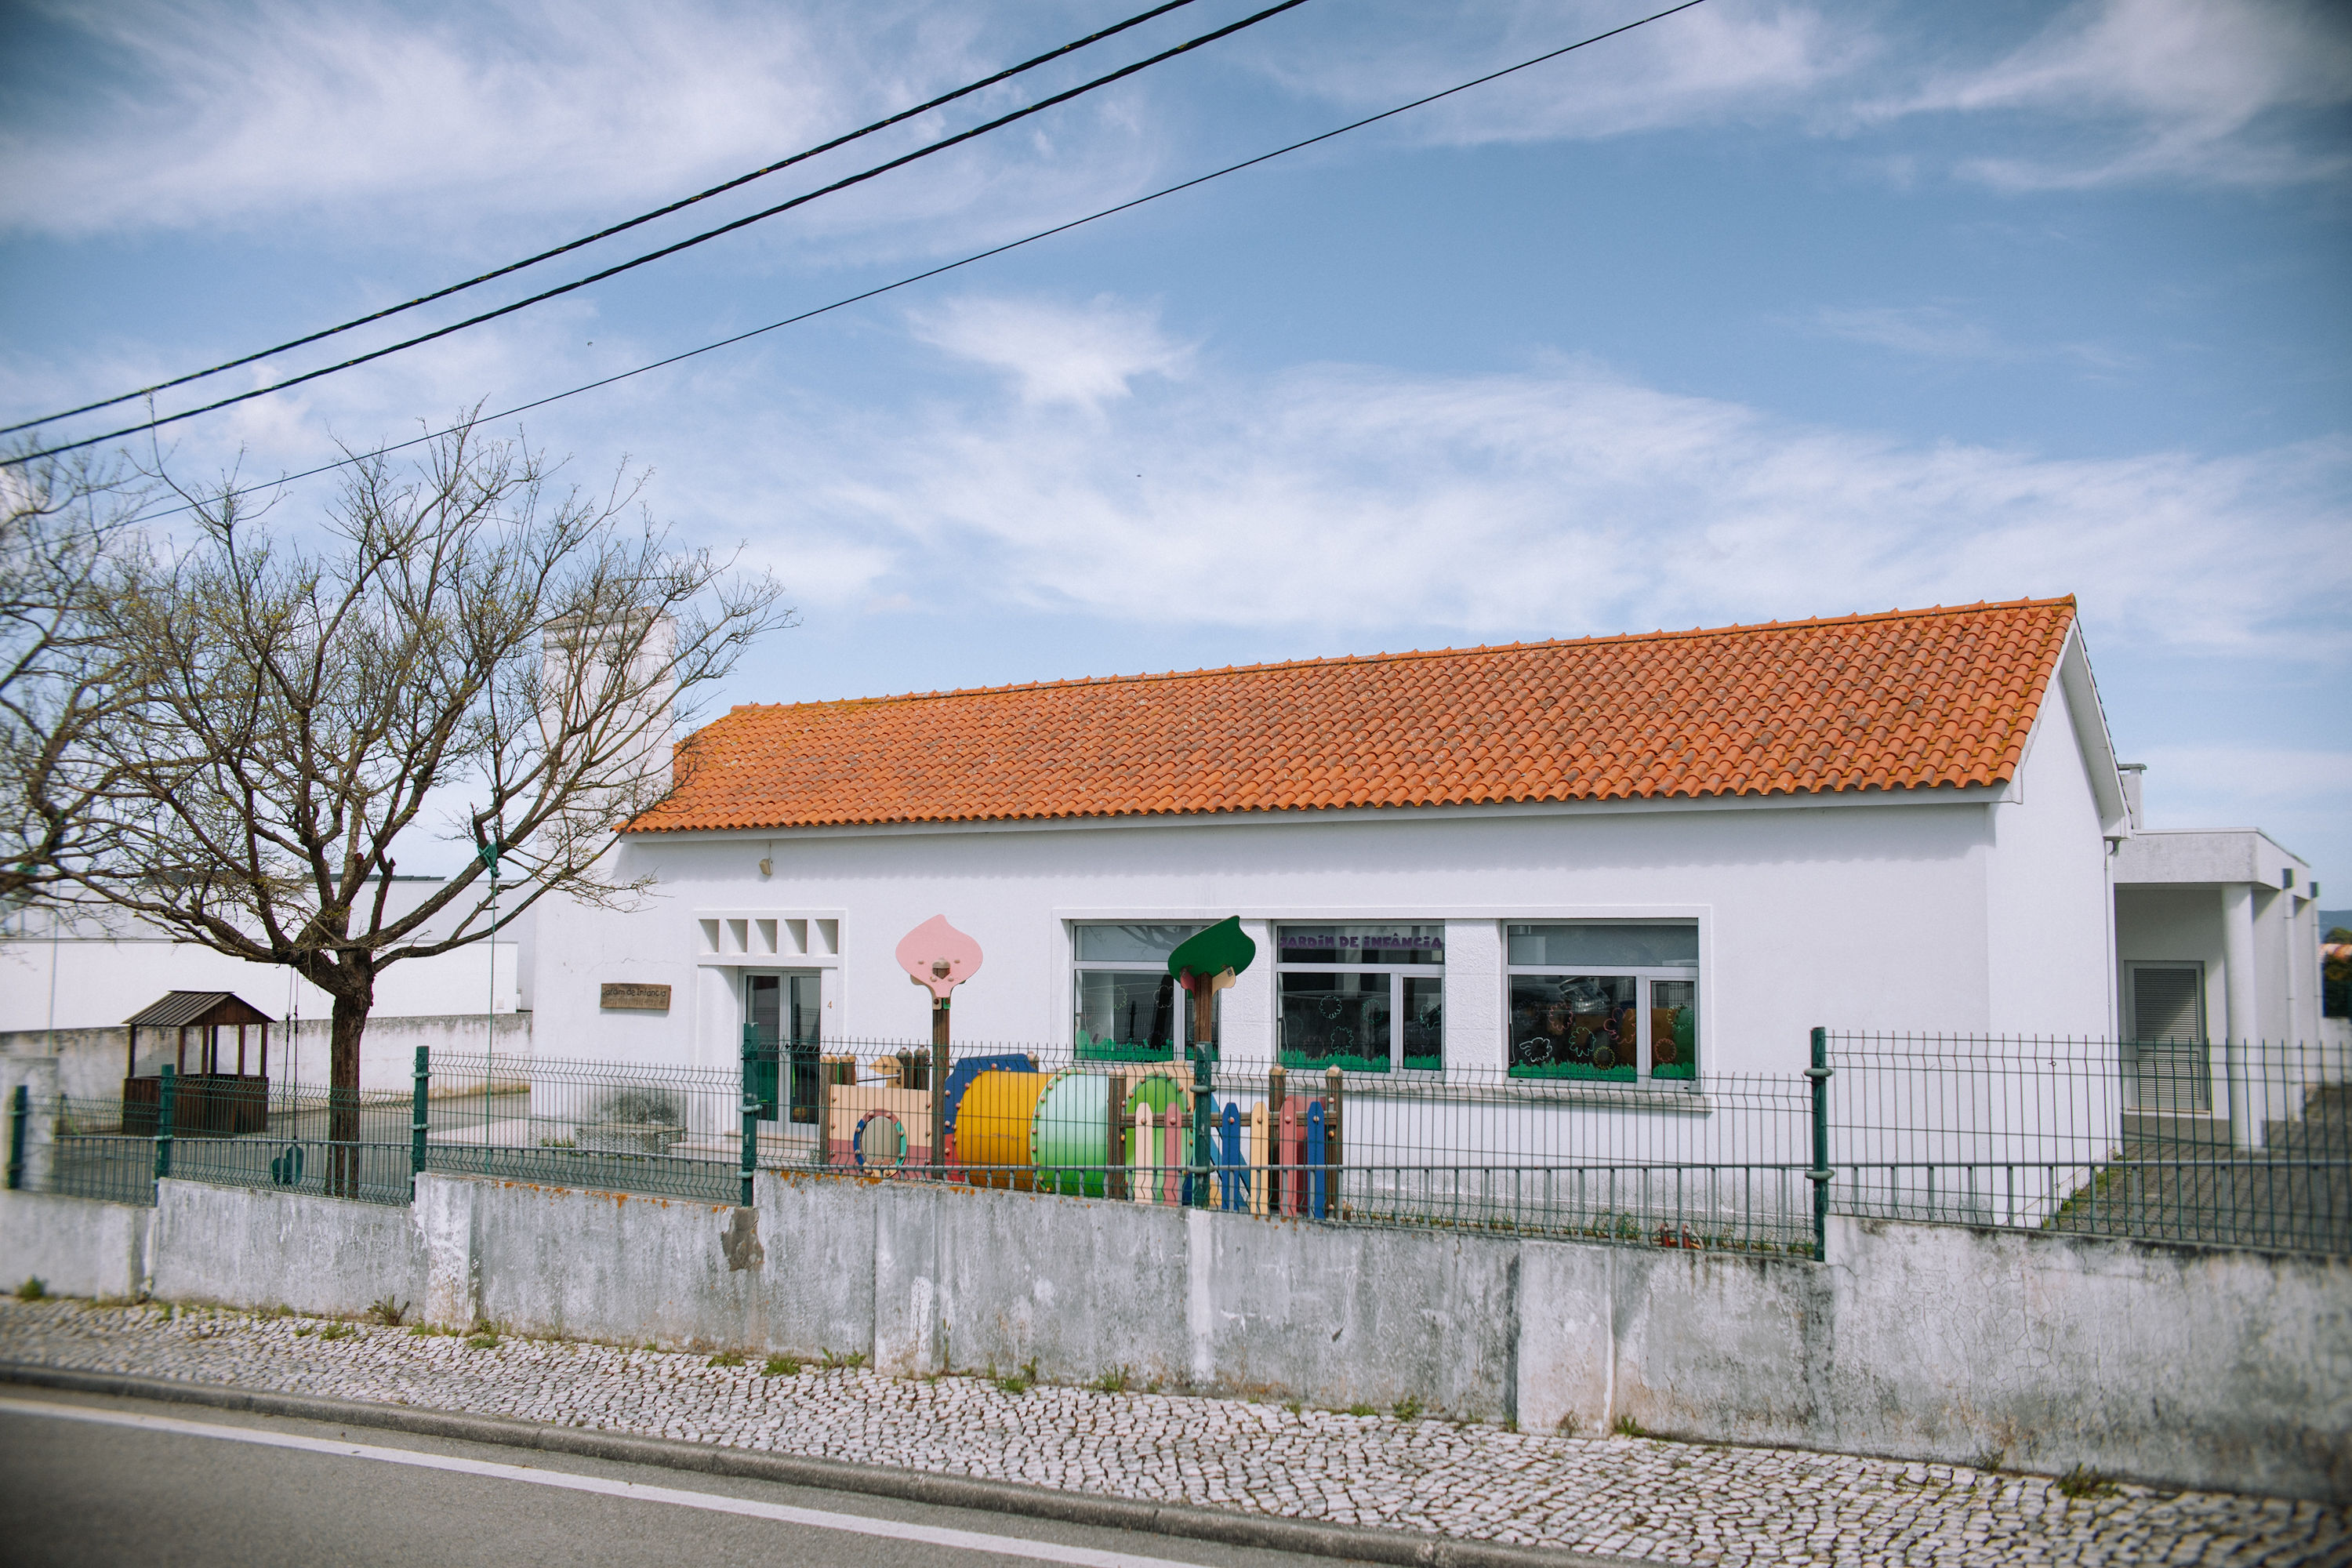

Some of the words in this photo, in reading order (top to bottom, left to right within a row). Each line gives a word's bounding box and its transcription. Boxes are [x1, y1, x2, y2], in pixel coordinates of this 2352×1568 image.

[1339, 935, 1359, 948] DE
[626, 988, 636, 996] de
[827, 1000, 833, 1009] 4
